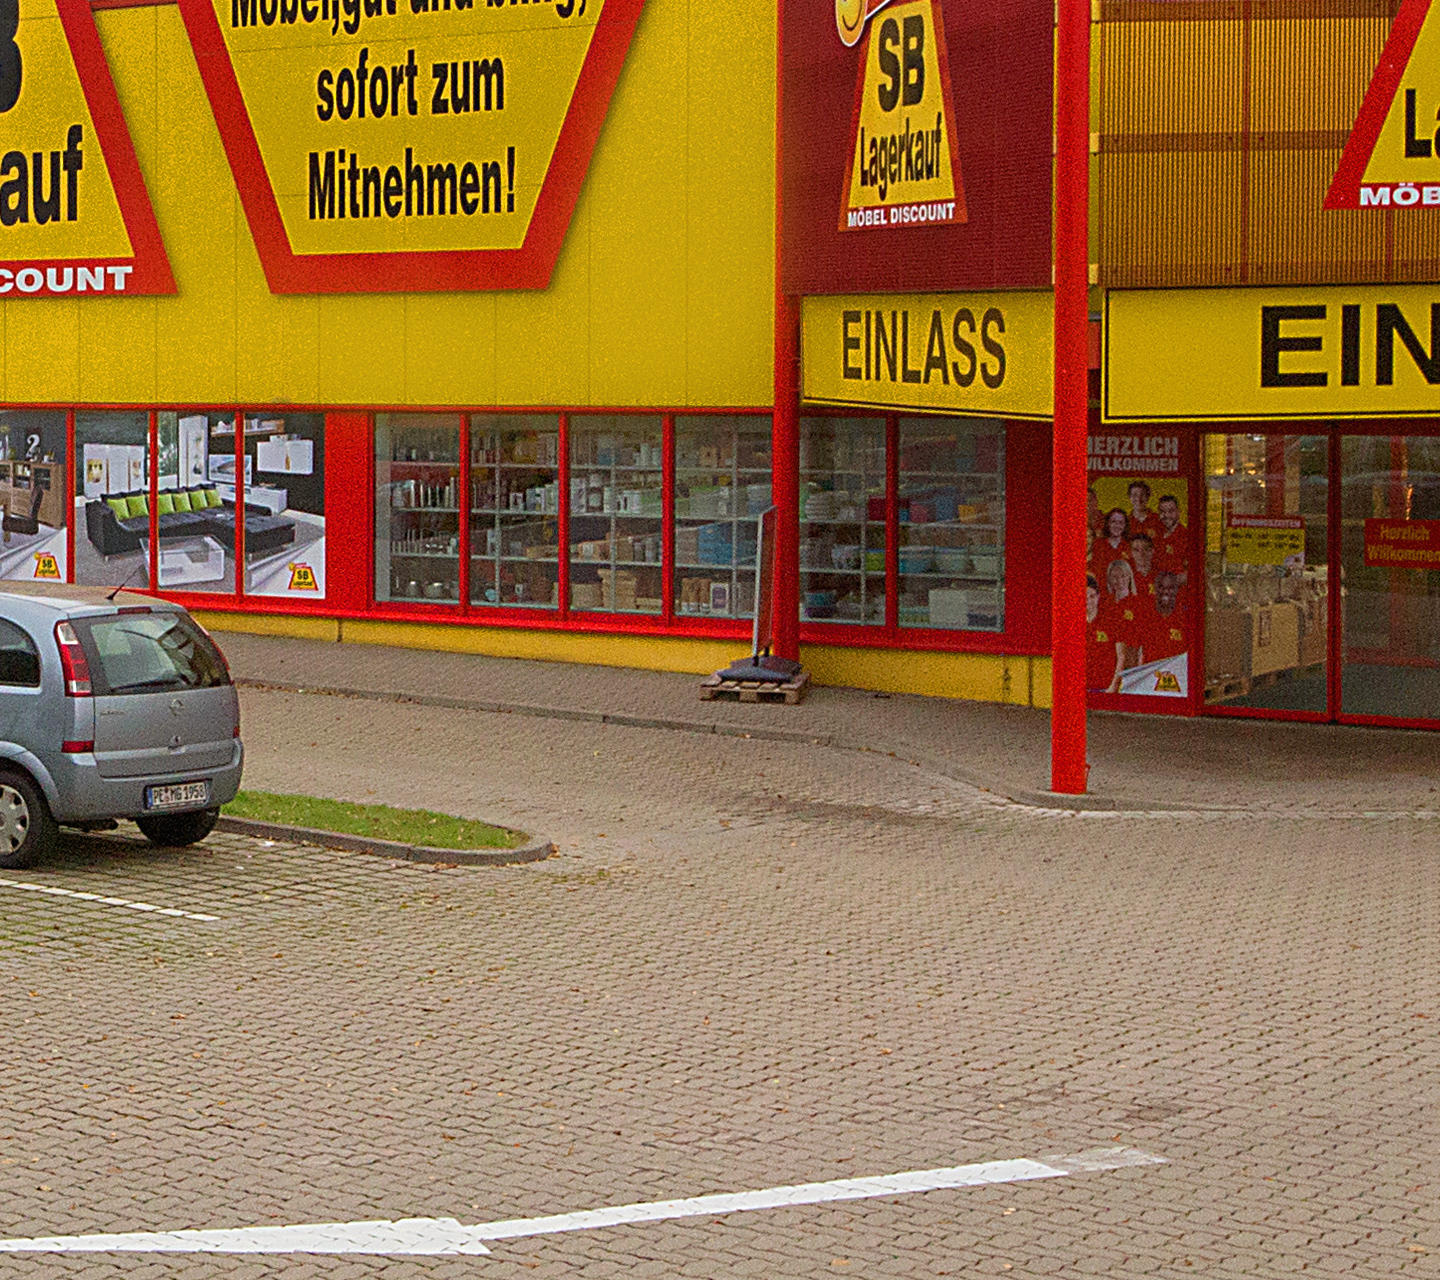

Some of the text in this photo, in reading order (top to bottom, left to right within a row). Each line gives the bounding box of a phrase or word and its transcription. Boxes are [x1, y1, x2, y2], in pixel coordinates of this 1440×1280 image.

[316, 48, 504, 121] sofort zum
[877, 14, 925, 112] SB
[308, 146, 515, 220] Mitnehmen!
[860, 112, 942, 202] Lagerkauf
[847, 202, 956, 228] MÖBEL DISCOUNT
[842, 307, 1006, 388] EINLASS
[1379, 524, 1431, 542] Herzlich
